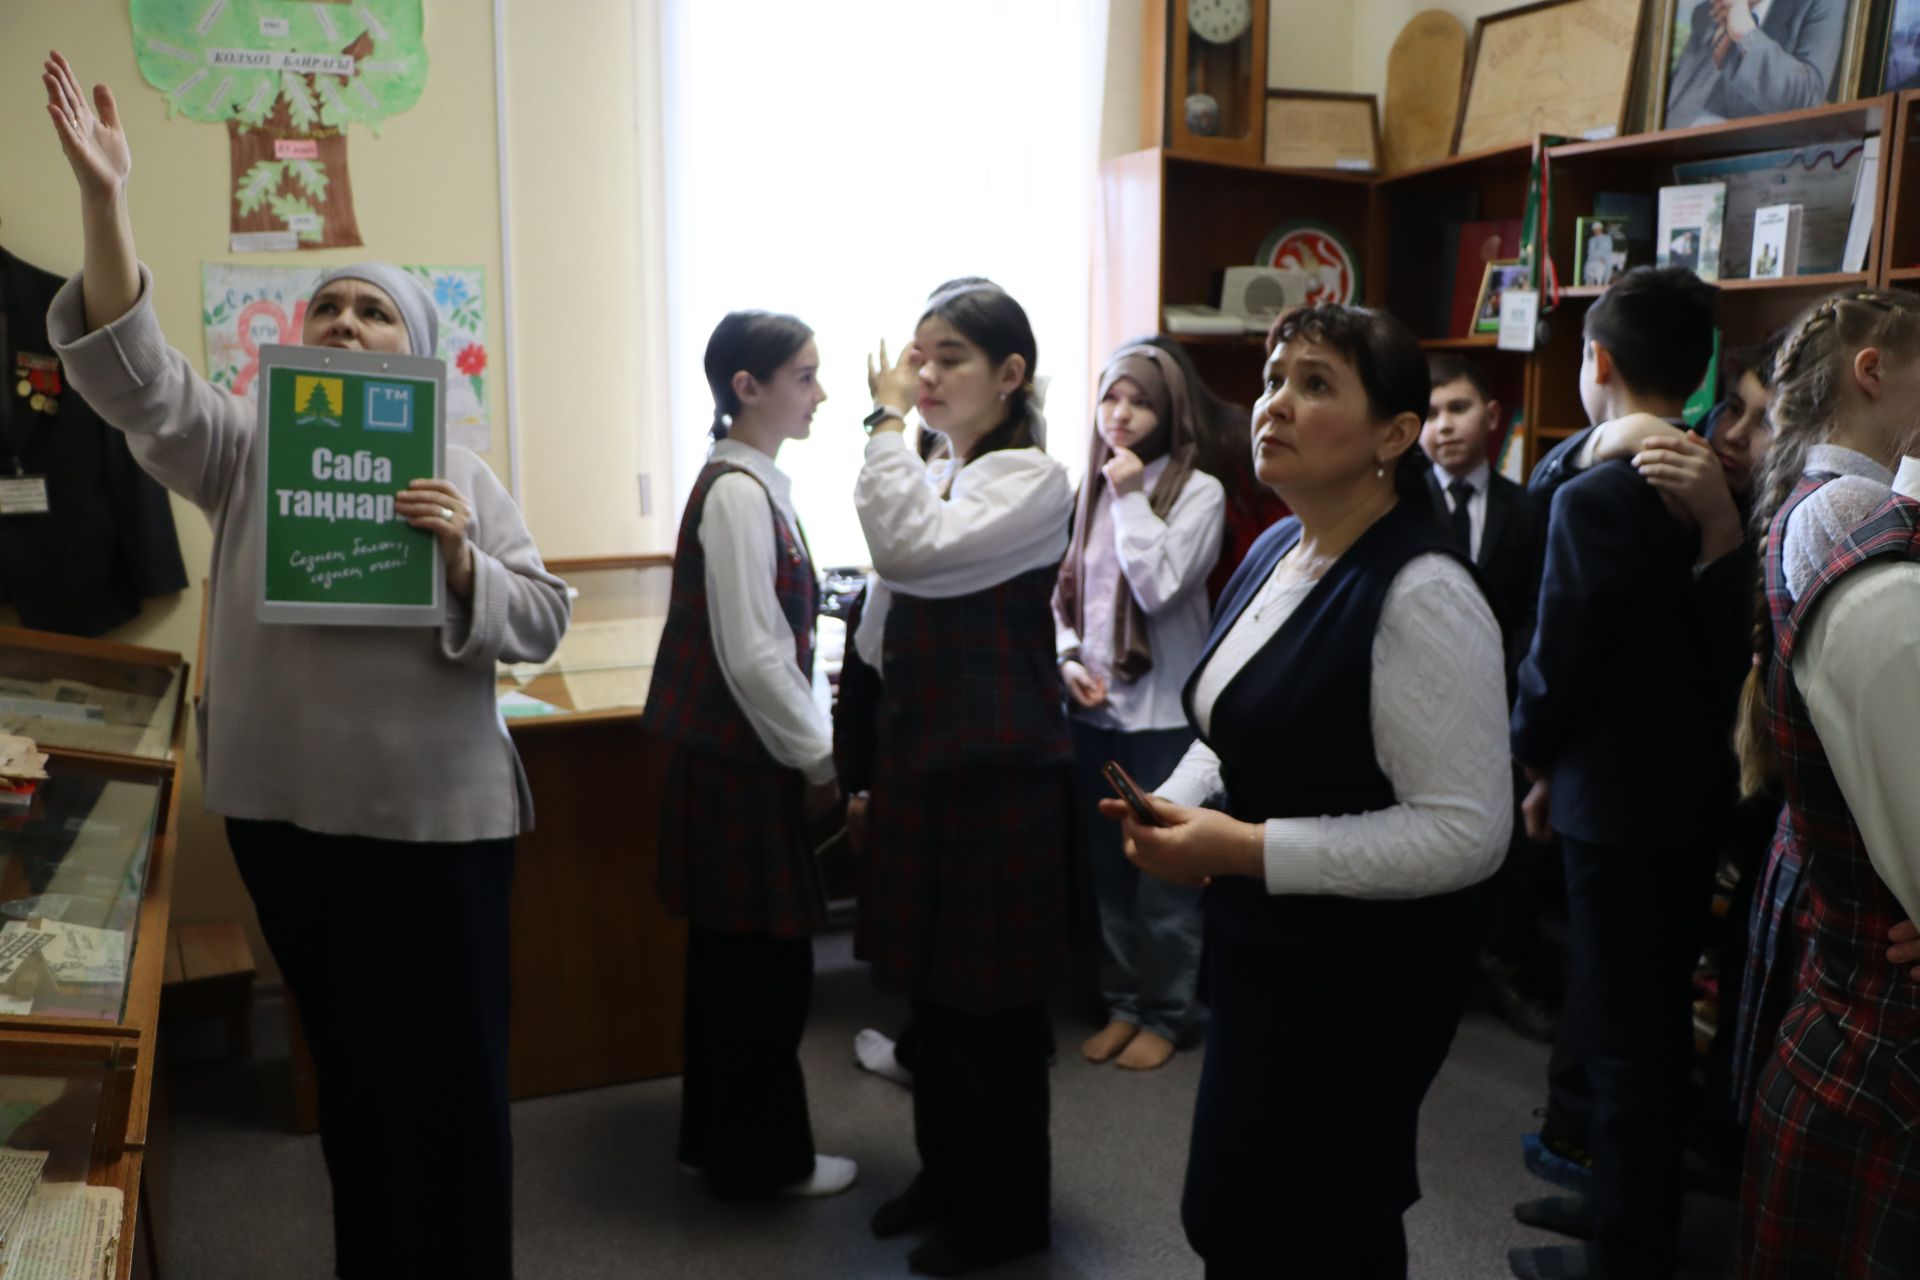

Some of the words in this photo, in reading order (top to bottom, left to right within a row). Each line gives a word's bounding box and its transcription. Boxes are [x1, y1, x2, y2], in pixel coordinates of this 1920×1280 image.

[214, 51, 271, 66] КОЛХОЗ
[384, 388, 409, 402] ТМ
[312, 447, 392, 483] Саба
[276, 488, 409, 524] таңнар
